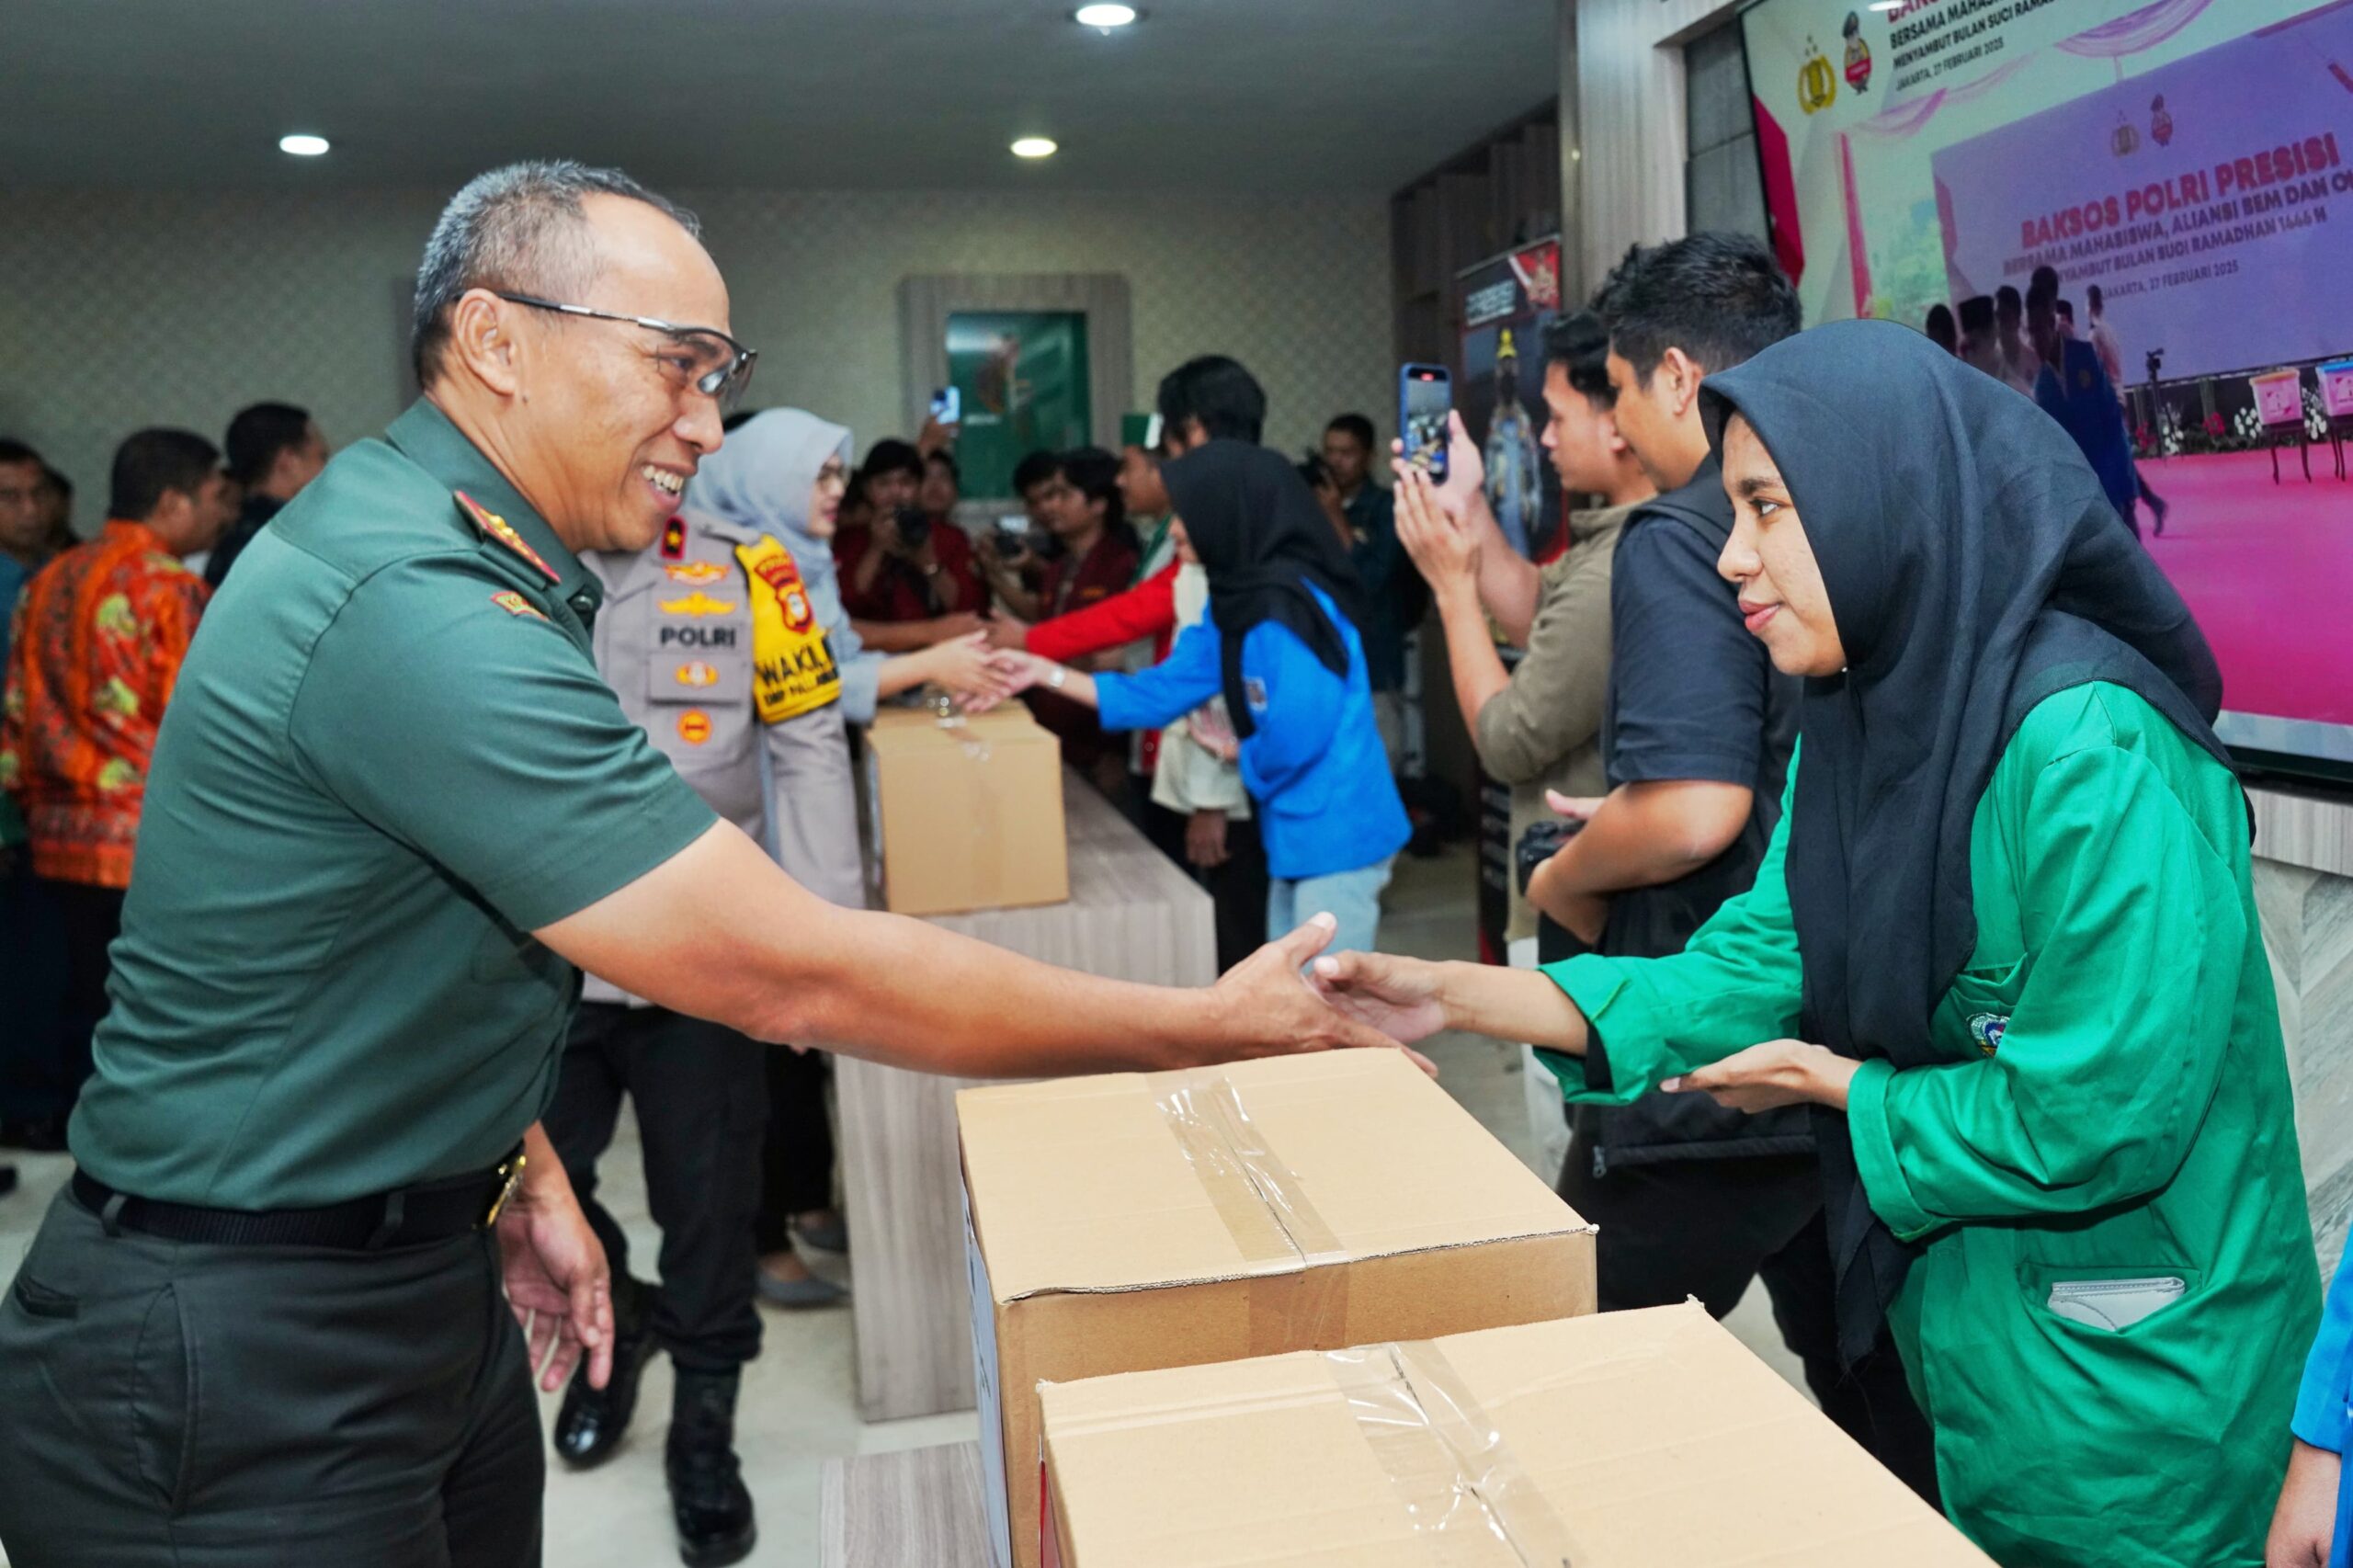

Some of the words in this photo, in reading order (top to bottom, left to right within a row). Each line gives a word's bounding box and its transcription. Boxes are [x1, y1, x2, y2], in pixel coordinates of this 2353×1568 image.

[1890, 11, 1946, 50] BERSAMA
[1893, 33, 1952, 70] MENYAMBUT
[1952, 18, 1987, 45] BULAN
[1987, 6, 2014, 28] SUCI
[2022, 195, 2120, 249] BAKSOS
[2126, 169, 2210, 222] POLRI
[2215, 131, 2340, 197] PRESISI
[2284, 176, 2329, 205] DAN
[660, 627, 736, 647] POLRI
